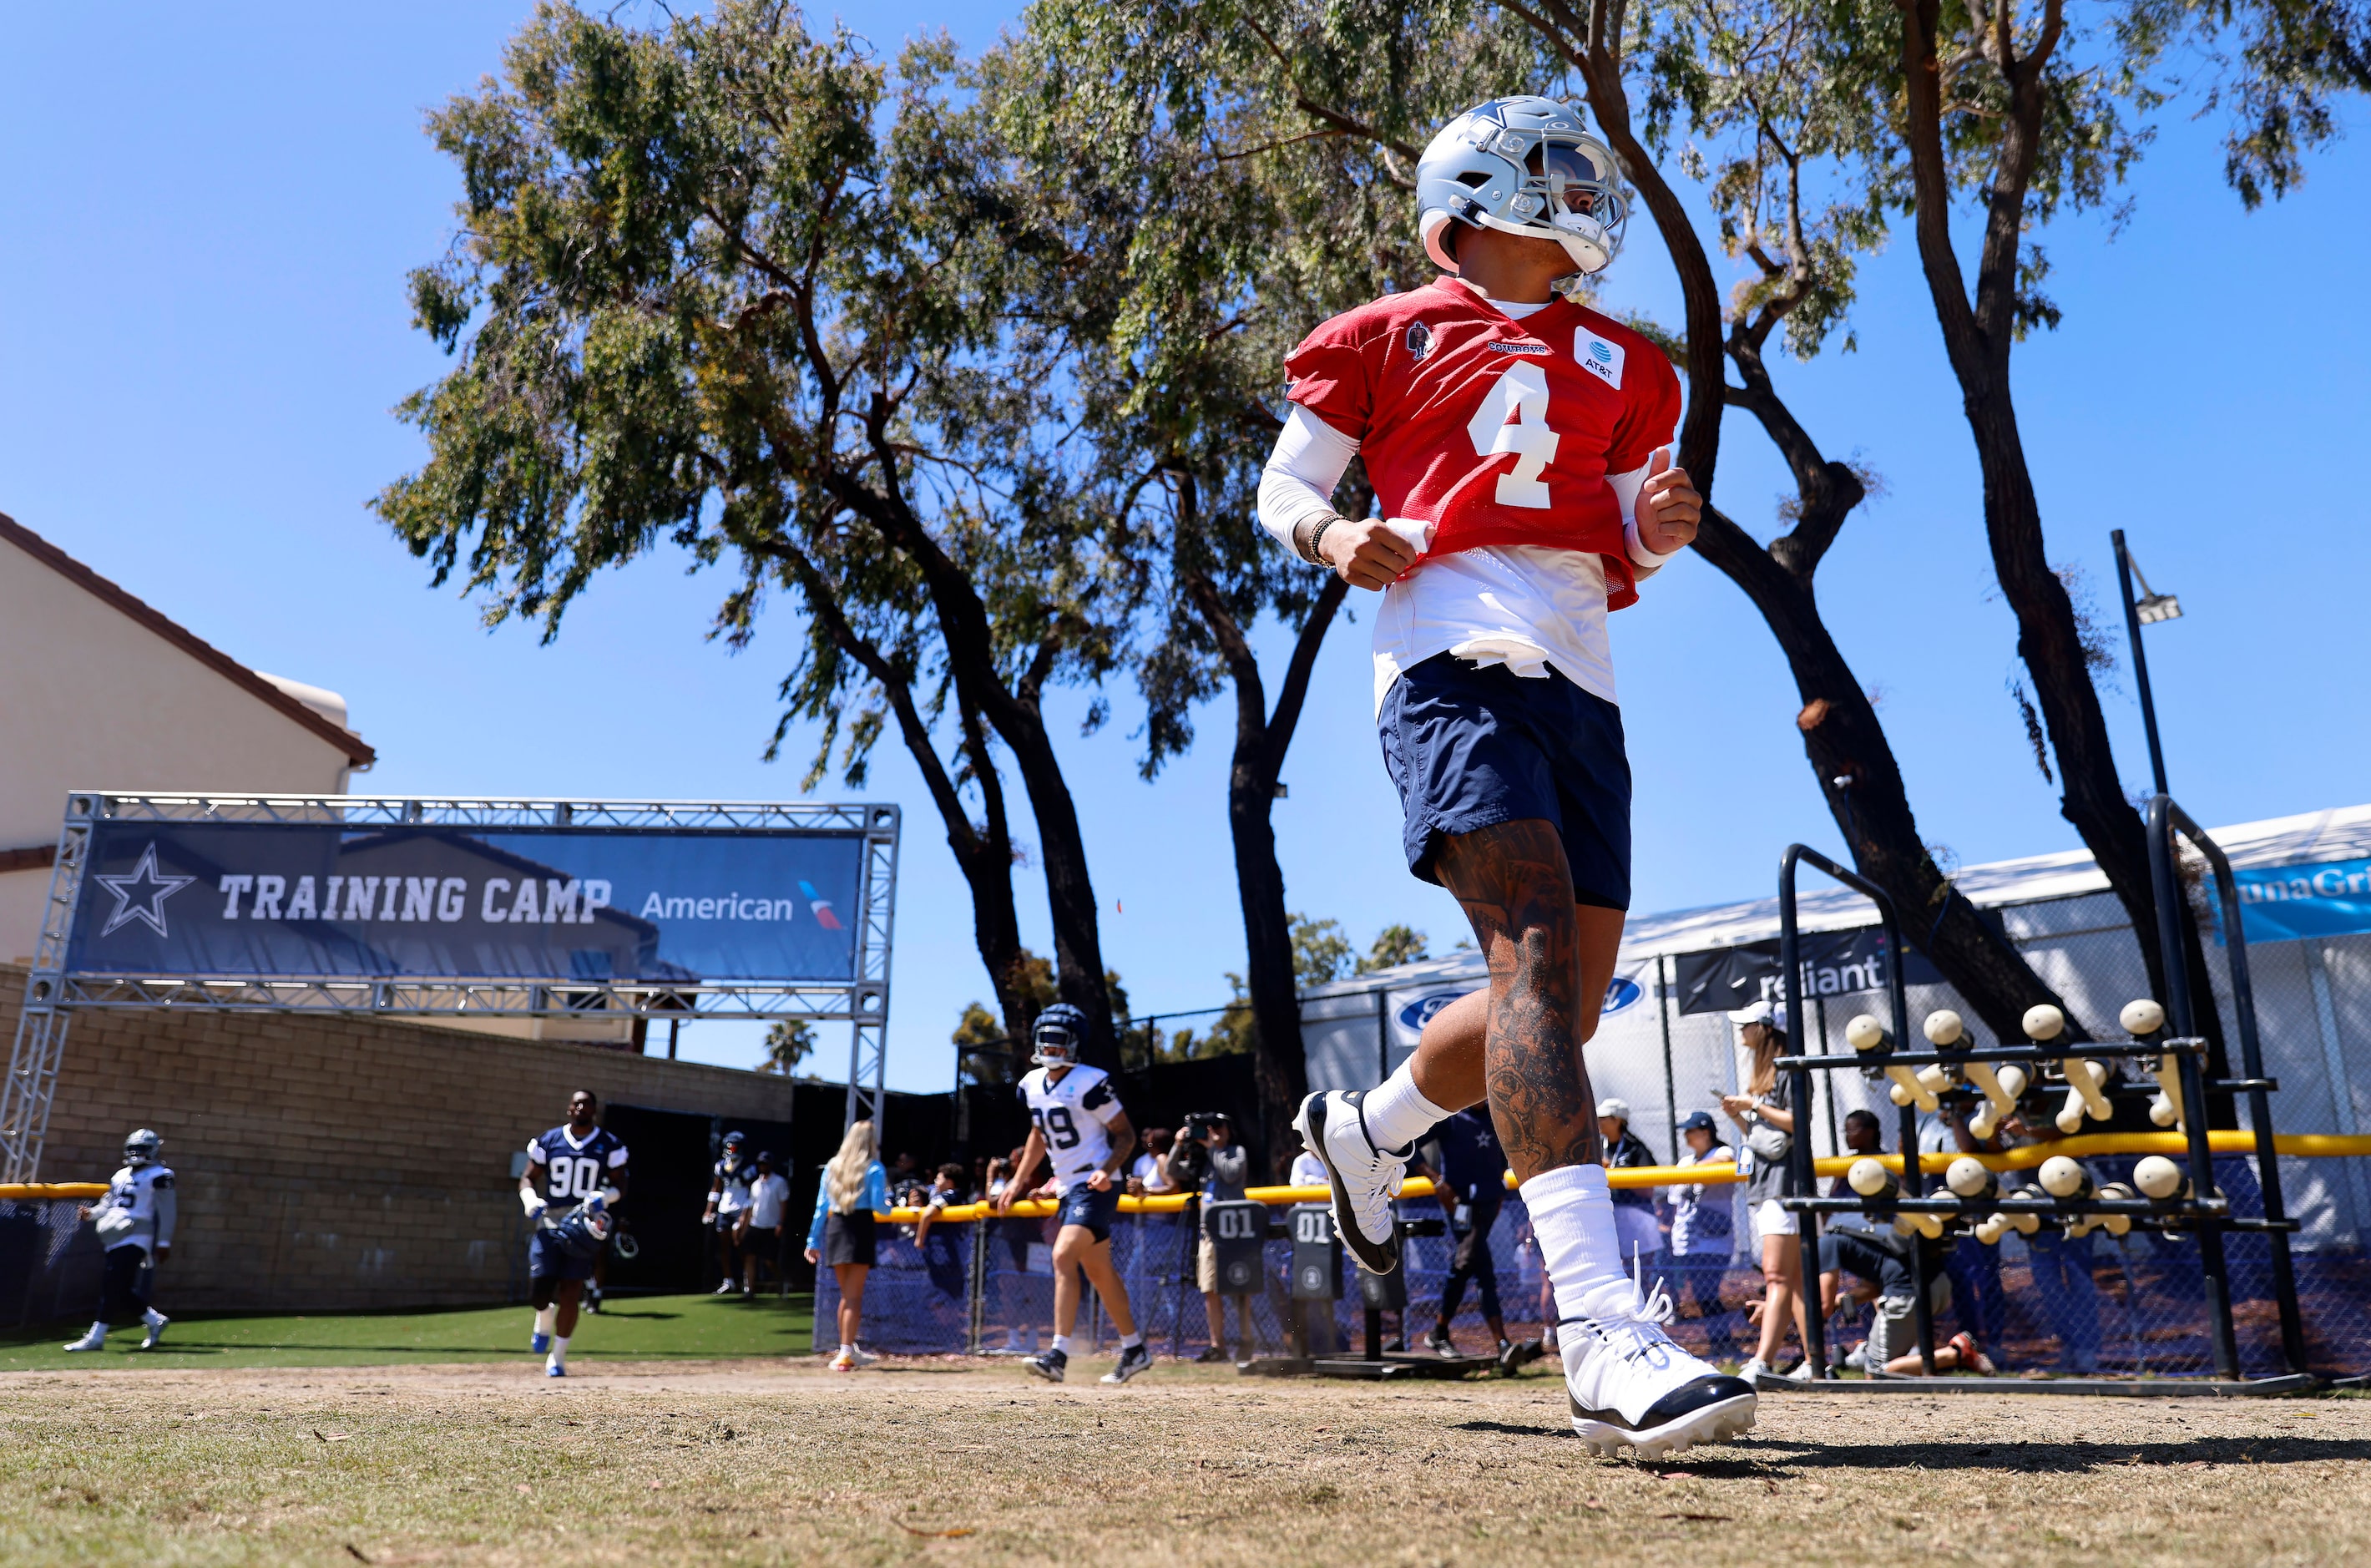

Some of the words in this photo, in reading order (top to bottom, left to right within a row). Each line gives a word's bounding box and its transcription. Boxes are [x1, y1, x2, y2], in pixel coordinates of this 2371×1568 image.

[1488, 341, 1546, 354] COWBOYS
[1585, 358, 1613, 379] AT&T
[1467, 360, 1560, 509] 4
[219, 874, 466, 923] TRAINING
[480, 876, 613, 924] CAMP
[2237, 865, 2371, 904] unaGri
[640, 891, 792, 922] American
[1760, 953, 1885, 1001] reliant
[549, 1156, 600, 1199] 90
[1297, 1211, 1332, 1244] 01
